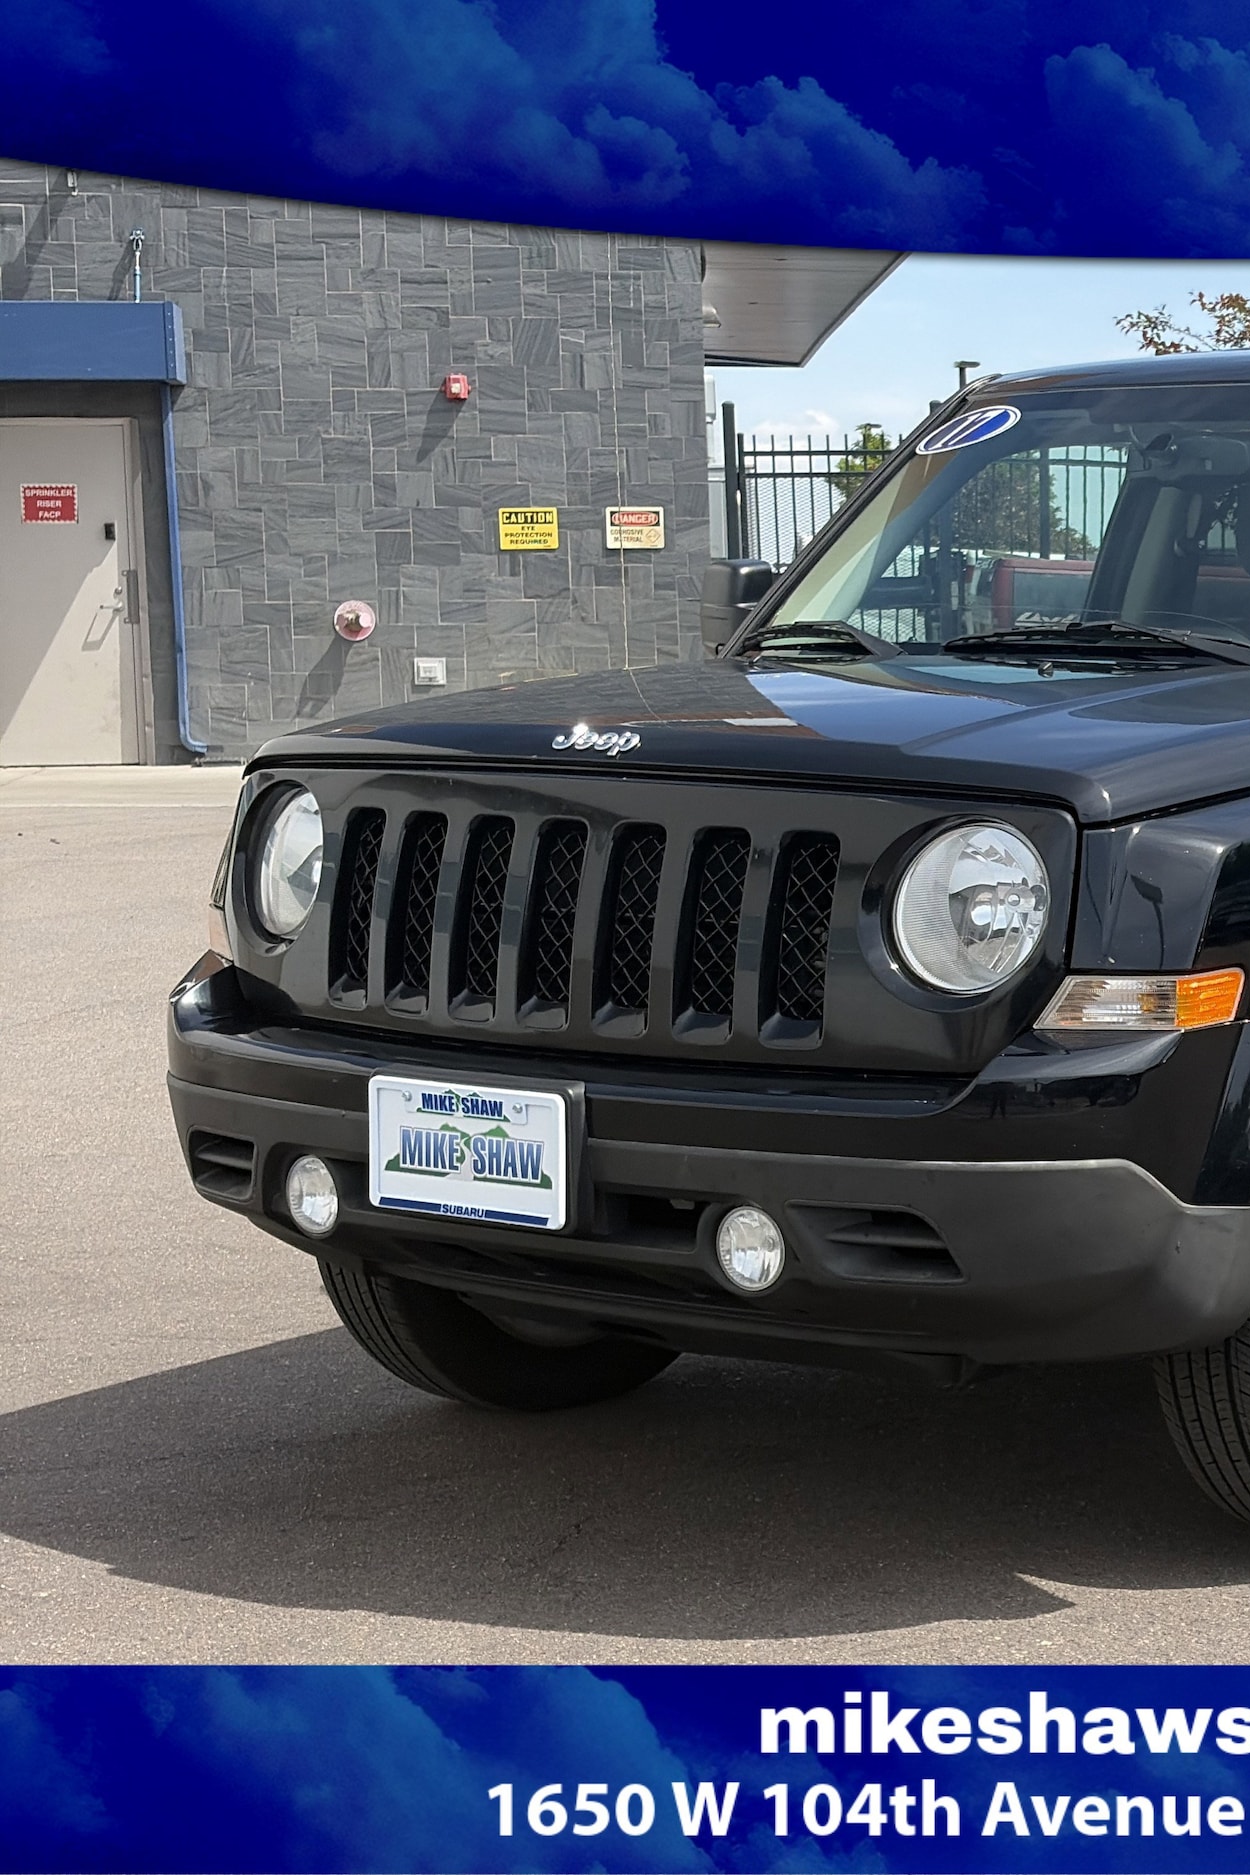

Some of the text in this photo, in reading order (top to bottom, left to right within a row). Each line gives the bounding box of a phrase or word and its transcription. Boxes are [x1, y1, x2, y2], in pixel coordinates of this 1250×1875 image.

[25, 489, 73, 497] SPRINKLER
[37, 500, 62, 508] RISER
[39, 511, 61, 519] FACP
[503, 512, 553, 524] CAUTION
[552, 723, 641, 757] Jeep
[421, 1092, 504, 1118] MIKE SHAW
[400, 1127, 543, 1182] MIKE SHAW
[441, 1204, 486, 1219] SUBARU
